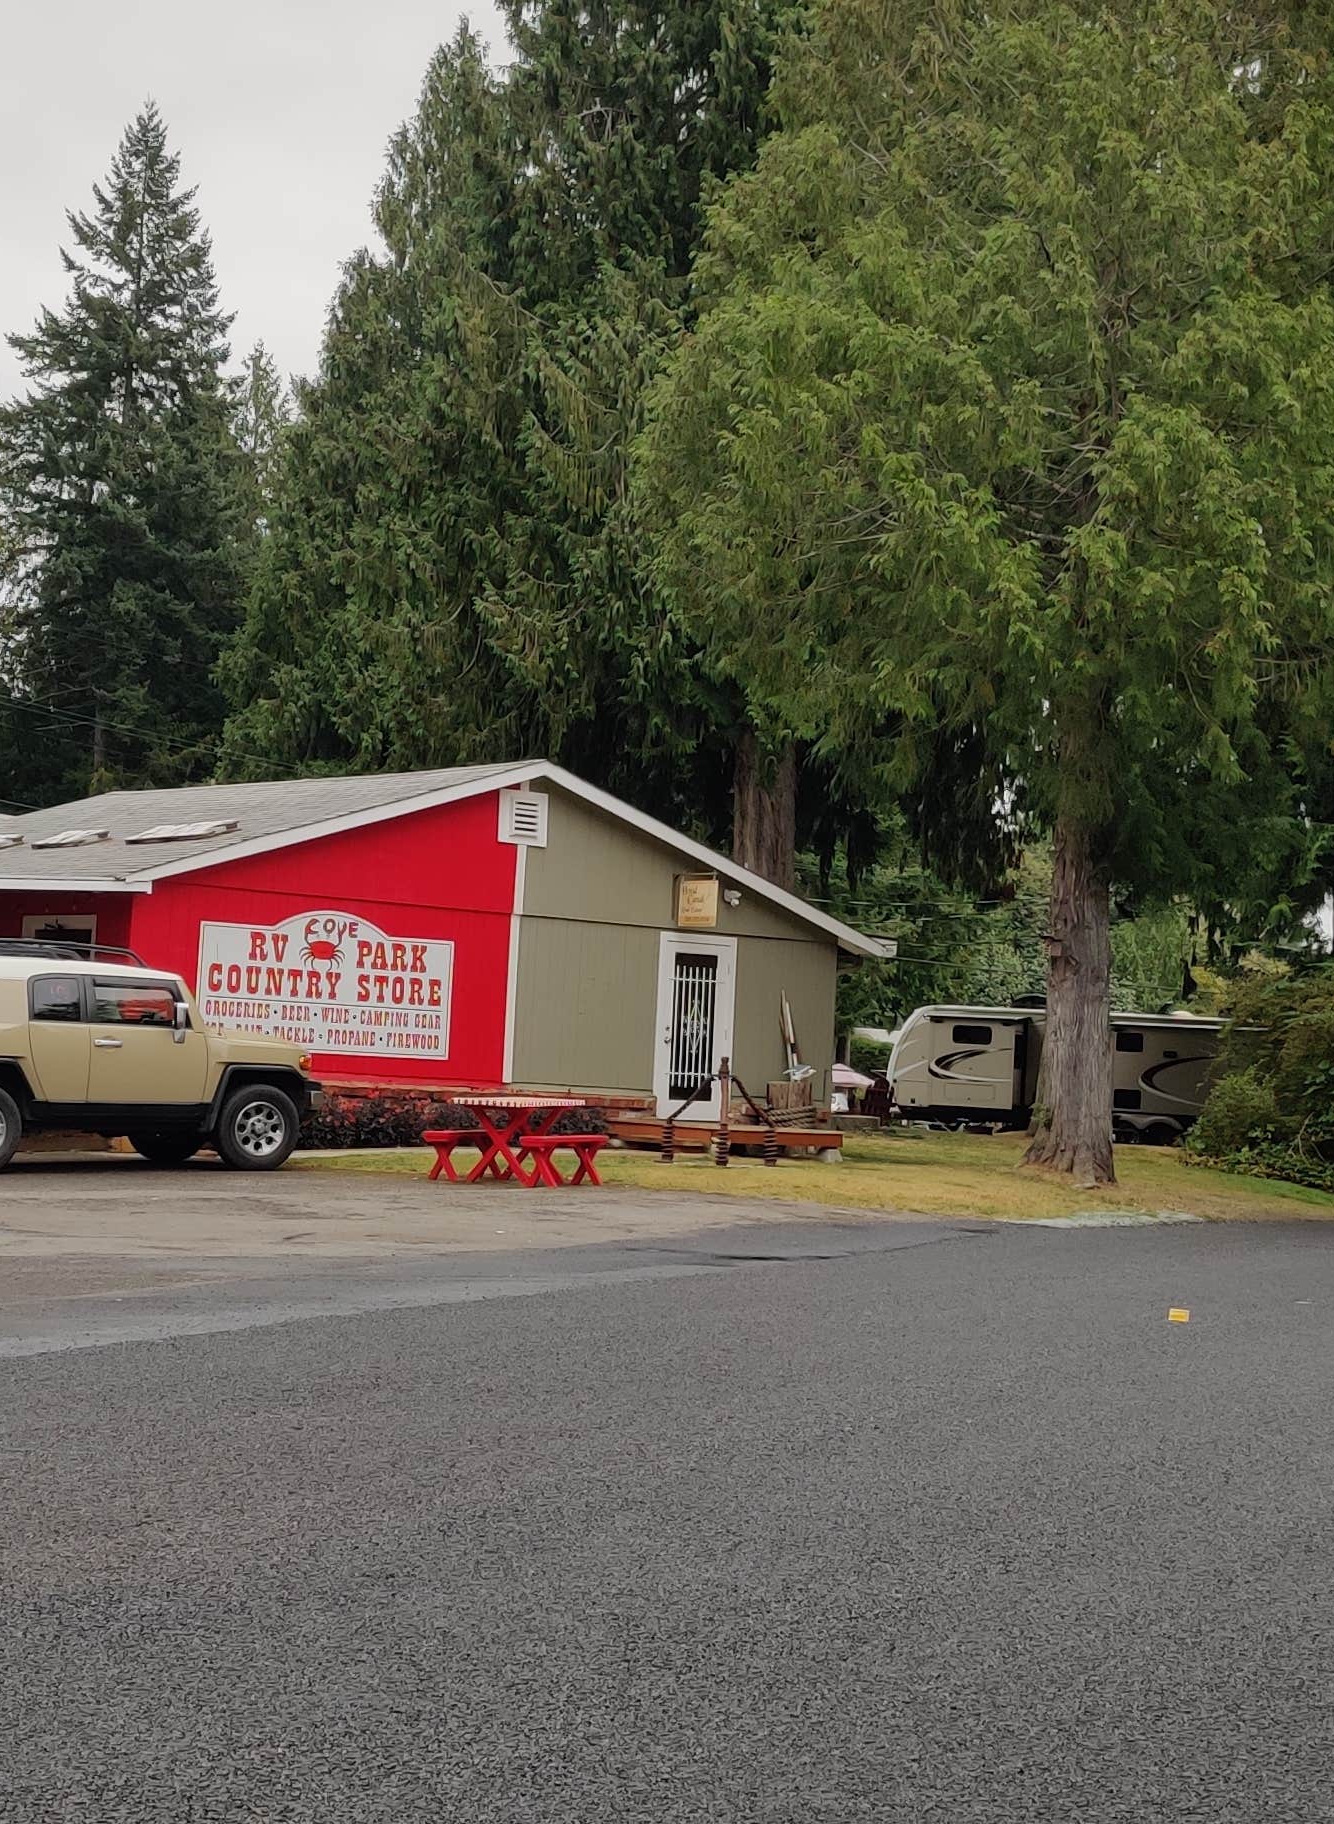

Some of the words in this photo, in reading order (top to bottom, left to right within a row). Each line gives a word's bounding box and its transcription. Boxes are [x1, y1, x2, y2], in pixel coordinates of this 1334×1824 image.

[304, 918, 359, 939] COVE
[248, 931, 289, 963] RV
[356, 940, 428, 974] PARK
[208, 963, 342, 1000] COUNTRY
[357, 974, 442, 1007] STORE
[205, 1000, 271, 1020] GROCERIES
[281, 1005, 310, 1022] BEER
[321, 1007, 350, 1024] WINE
[360, 1010, 409, 1028] CAMPING
[414, 1014, 441, 1030] GEAR
[273, 1025, 315, 1044] TACKLE
[327, 1029, 376, 1047] PROPANE
[386, 1032, 440, 1050] FIREWOOD
